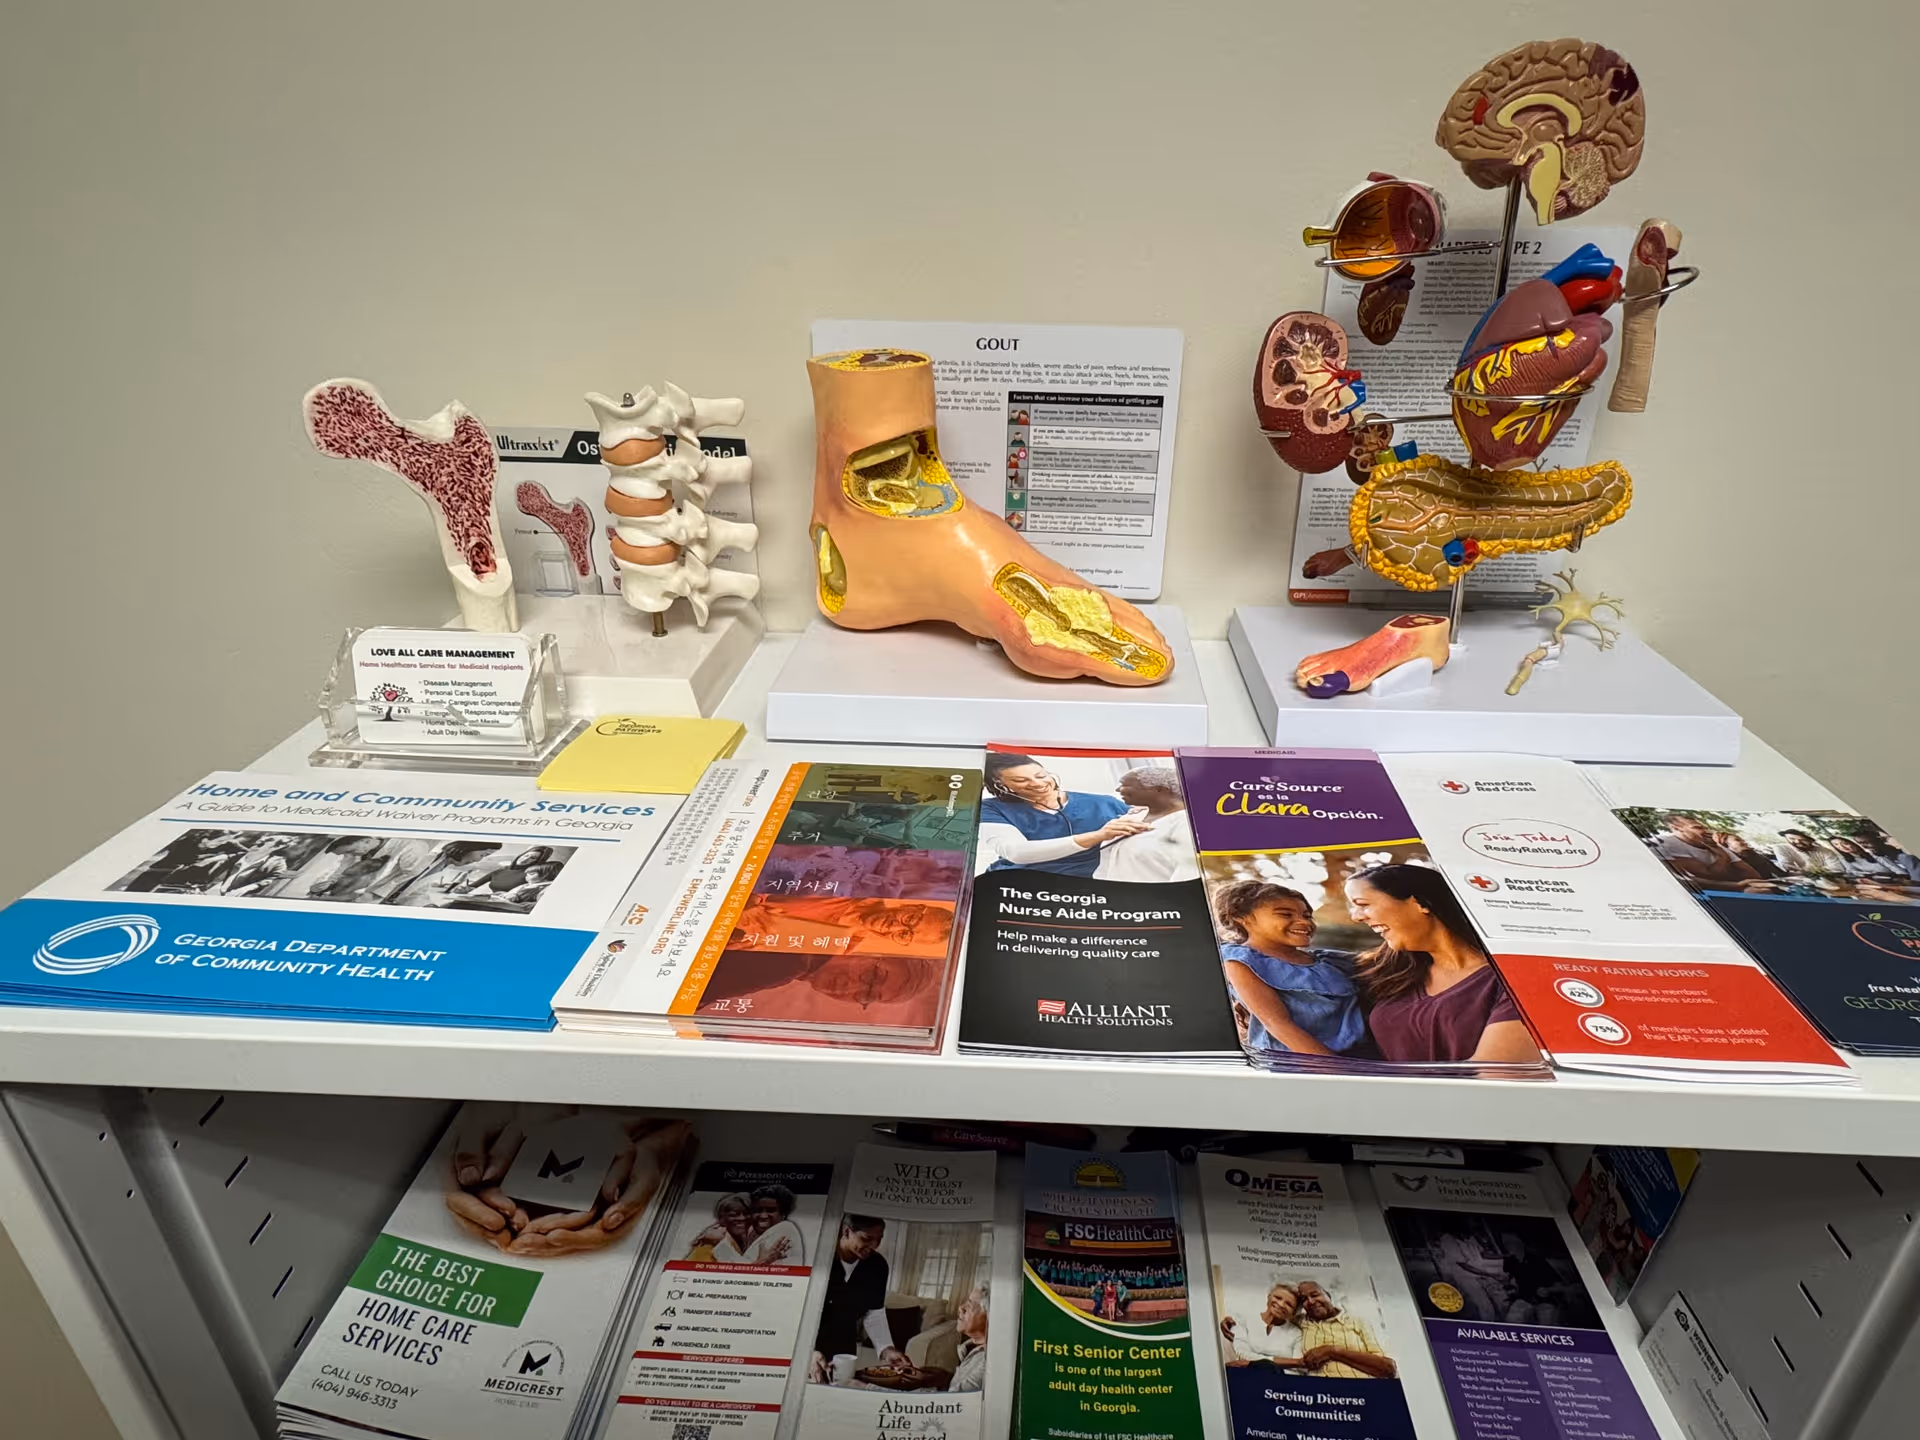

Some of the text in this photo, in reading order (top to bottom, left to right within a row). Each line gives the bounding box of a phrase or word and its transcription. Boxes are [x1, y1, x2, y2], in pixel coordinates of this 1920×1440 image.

[1533, 241, 1542, 254] 2
[976, 338, 1020, 351] GOUT
[702, 446, 736, 459] odel
[371, 648, 516, 659] LOVE ALL CARE MANAGEMENT
[450, 680, 493, 688] Management
[424, 689, 453, 697] Personal
[471, 690, 497, 698] Support
[444, 729, 458, 737] Day
[1229, 780, 1343, 793] CareSource
[188, 782, 656, 819] Home and Community Services
[1216, 792, 1384, 821] Clara Opción.
[175, 802, 635, 833] A Guide to Medicaid Waiver Programs in Georgia
[787, 831, 821, 842] 주거
[1476, 831, 1571, 846] Join Today
[1483, 844, 1588, 856] ReadyRating.org
[651, 817, 737, 955] (404) 463-3333 EMPOWERLINE.ORG
[767, 879, 839, 894] 지역사회
[1504, 877, 1569, 887] American
[1507, 884, 1576, 894] Red Cross
[656, 819, 751, 978] 오늘 당신에게 필요한 서비스를 찾아보세요
[999, 887, 1107, 906] The Georgia
[999, 902, 1181, 923] Nurse Aide Program
[742, 934, 850, 949] 지원 및 혜택
[997, 930, 1148, 946] Help make a difference
[173, 932, 447, 963] GEORGIA DEPARTMENT
[997, 942, 1161, 960] in delivering quality care
[155, 951, 435, 982] OF COMMUNITY HEALTH
[1553, 963, 1709, 978] READY RATING WORKS
[1569, 990, 1594, 1000] 42%
[710, 998, 754, 1014] 교통
[1068, 1001, 1171, 1018] ALLIANT
[1843, 995, 1920, 1012] GEORG
[1039, 1013, 1174, 1027] HEALTH SOLUTIONS
[1591, 1025, 1619, 1034] 75%
[1638, 1024, 1770, 1038] of members have updated
[1643, 1033, 1769, 1047] their EAPs since joining.
[894, 1163, 950, 1180] WHO
[1224, 1169, 1324, 1194] OMEGA
[390, 1245, 485, 1287] THE BEST
[375, 1269, 498, 1318] CHOICE FOR
[356, 1296, 478, 1345] HOME CARE
[342, 1321, 443, 1366] SERVICES
[1457, 1328, 1575, 1346] AVAILABLE SERVICES
[1033, 1339, 1182, 1360] First Senior Center
[1054, 1362, 1163, 1379] is one of the largest
[320, 1364, 419, 1399] CALL US TODAY
[484, 1377, 565, 1397] MEDICREST
[1048, 1380, 1173, 1396] adult day health center
[311, 1377, 399, 1410] (404) 946-3313
[1264, 1388, 1366, 1406] Serving Diverse
[878, 1399, 964, 1415] Abundant
[1080, 1400, 1140, 1415] in Georgia.
[1275, 1405, 1362, 1423] Communities
[876, 1414, 912, 1430] Life
[1246, 1427, 1288, 1440] American
